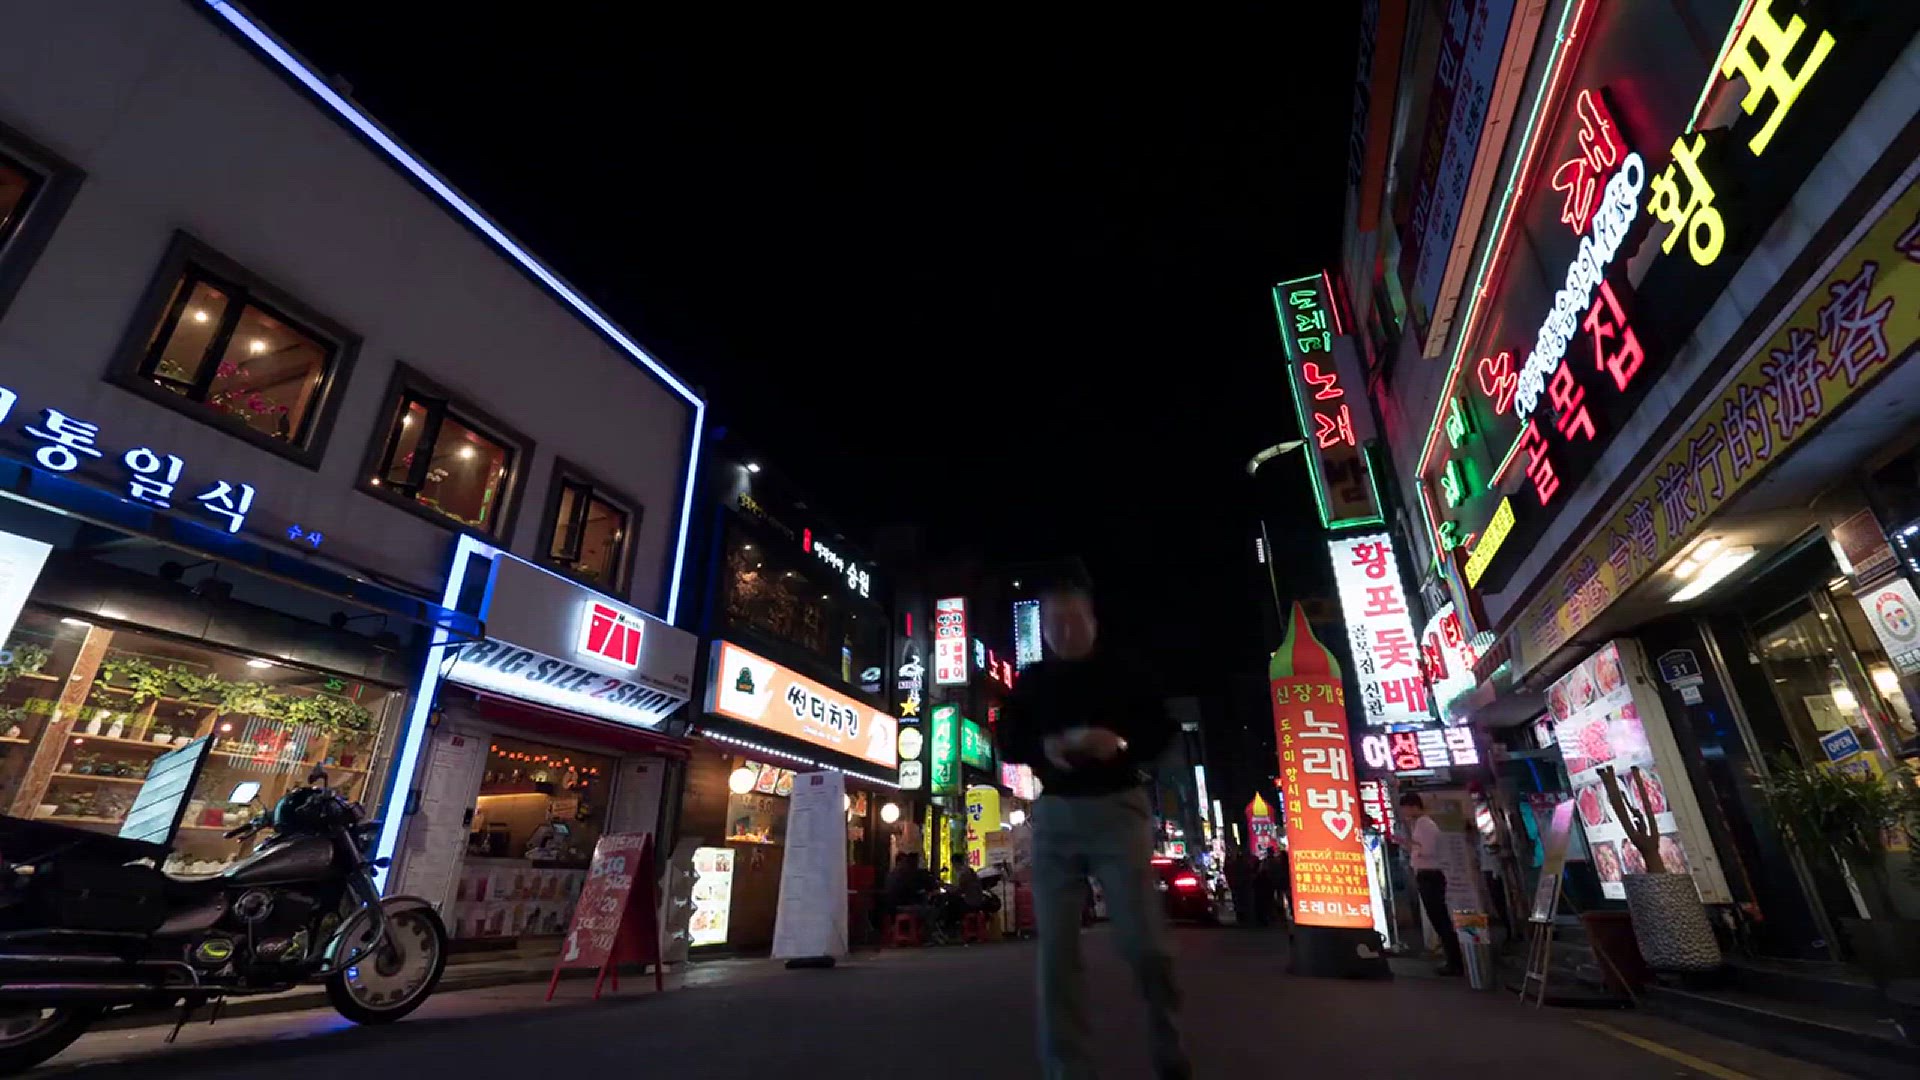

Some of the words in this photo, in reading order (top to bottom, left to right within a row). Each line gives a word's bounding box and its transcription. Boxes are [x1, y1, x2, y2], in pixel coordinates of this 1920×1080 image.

[1519, 280, 1645, 505] 골목집
[0, 385, 257, 534] 통일식
[460, 641, 532, 675] BIG
[525, 657, 600, 693] SIZE
[1671, 664, 1689, 677] 31
[787, 685, 859, 737] 썬더치킨
[1362, 726, 1480, 771] 여성클럽
[1826, 735, 1854, 753] OPEN
[1298, 709, 1356, 841] 노래방
